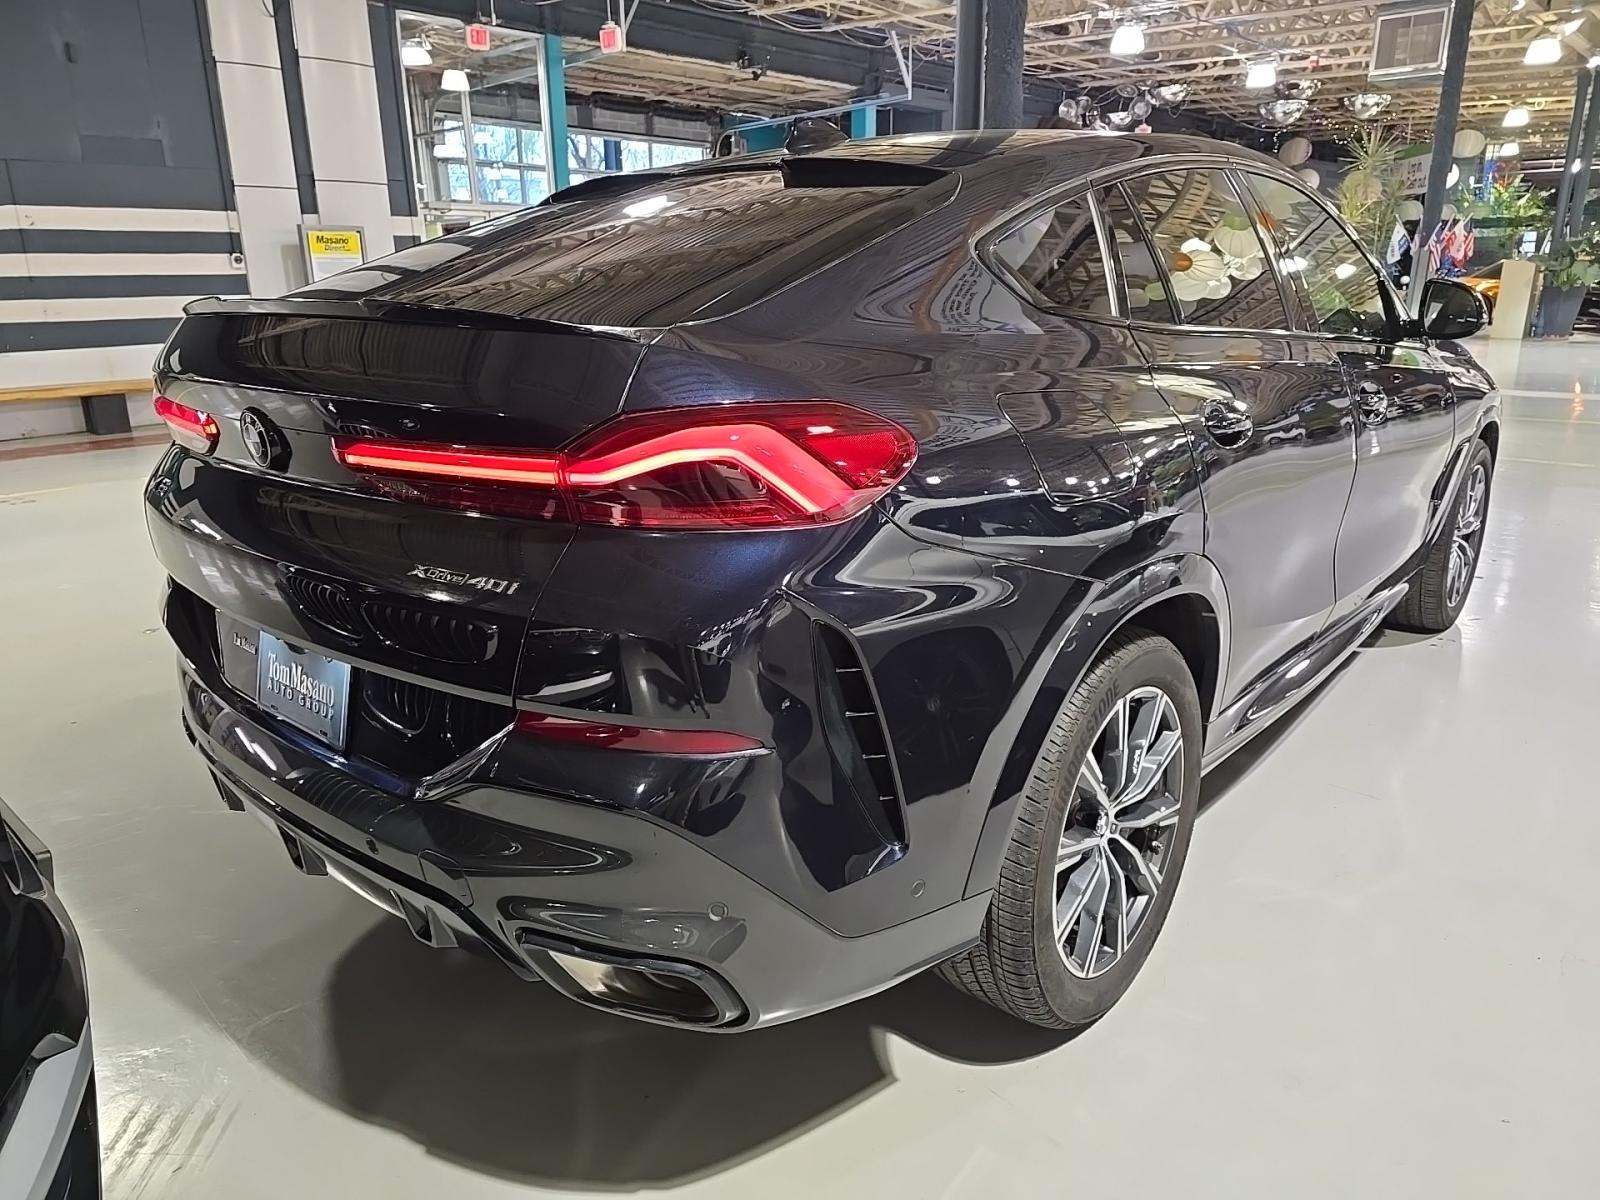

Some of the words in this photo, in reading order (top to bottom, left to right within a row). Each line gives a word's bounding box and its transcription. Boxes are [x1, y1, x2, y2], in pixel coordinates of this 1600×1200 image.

[316, 234, 349, 245] Masano
[267, 678, 293, 700] AUTO
[298, 693, 334, 720] GROUP
